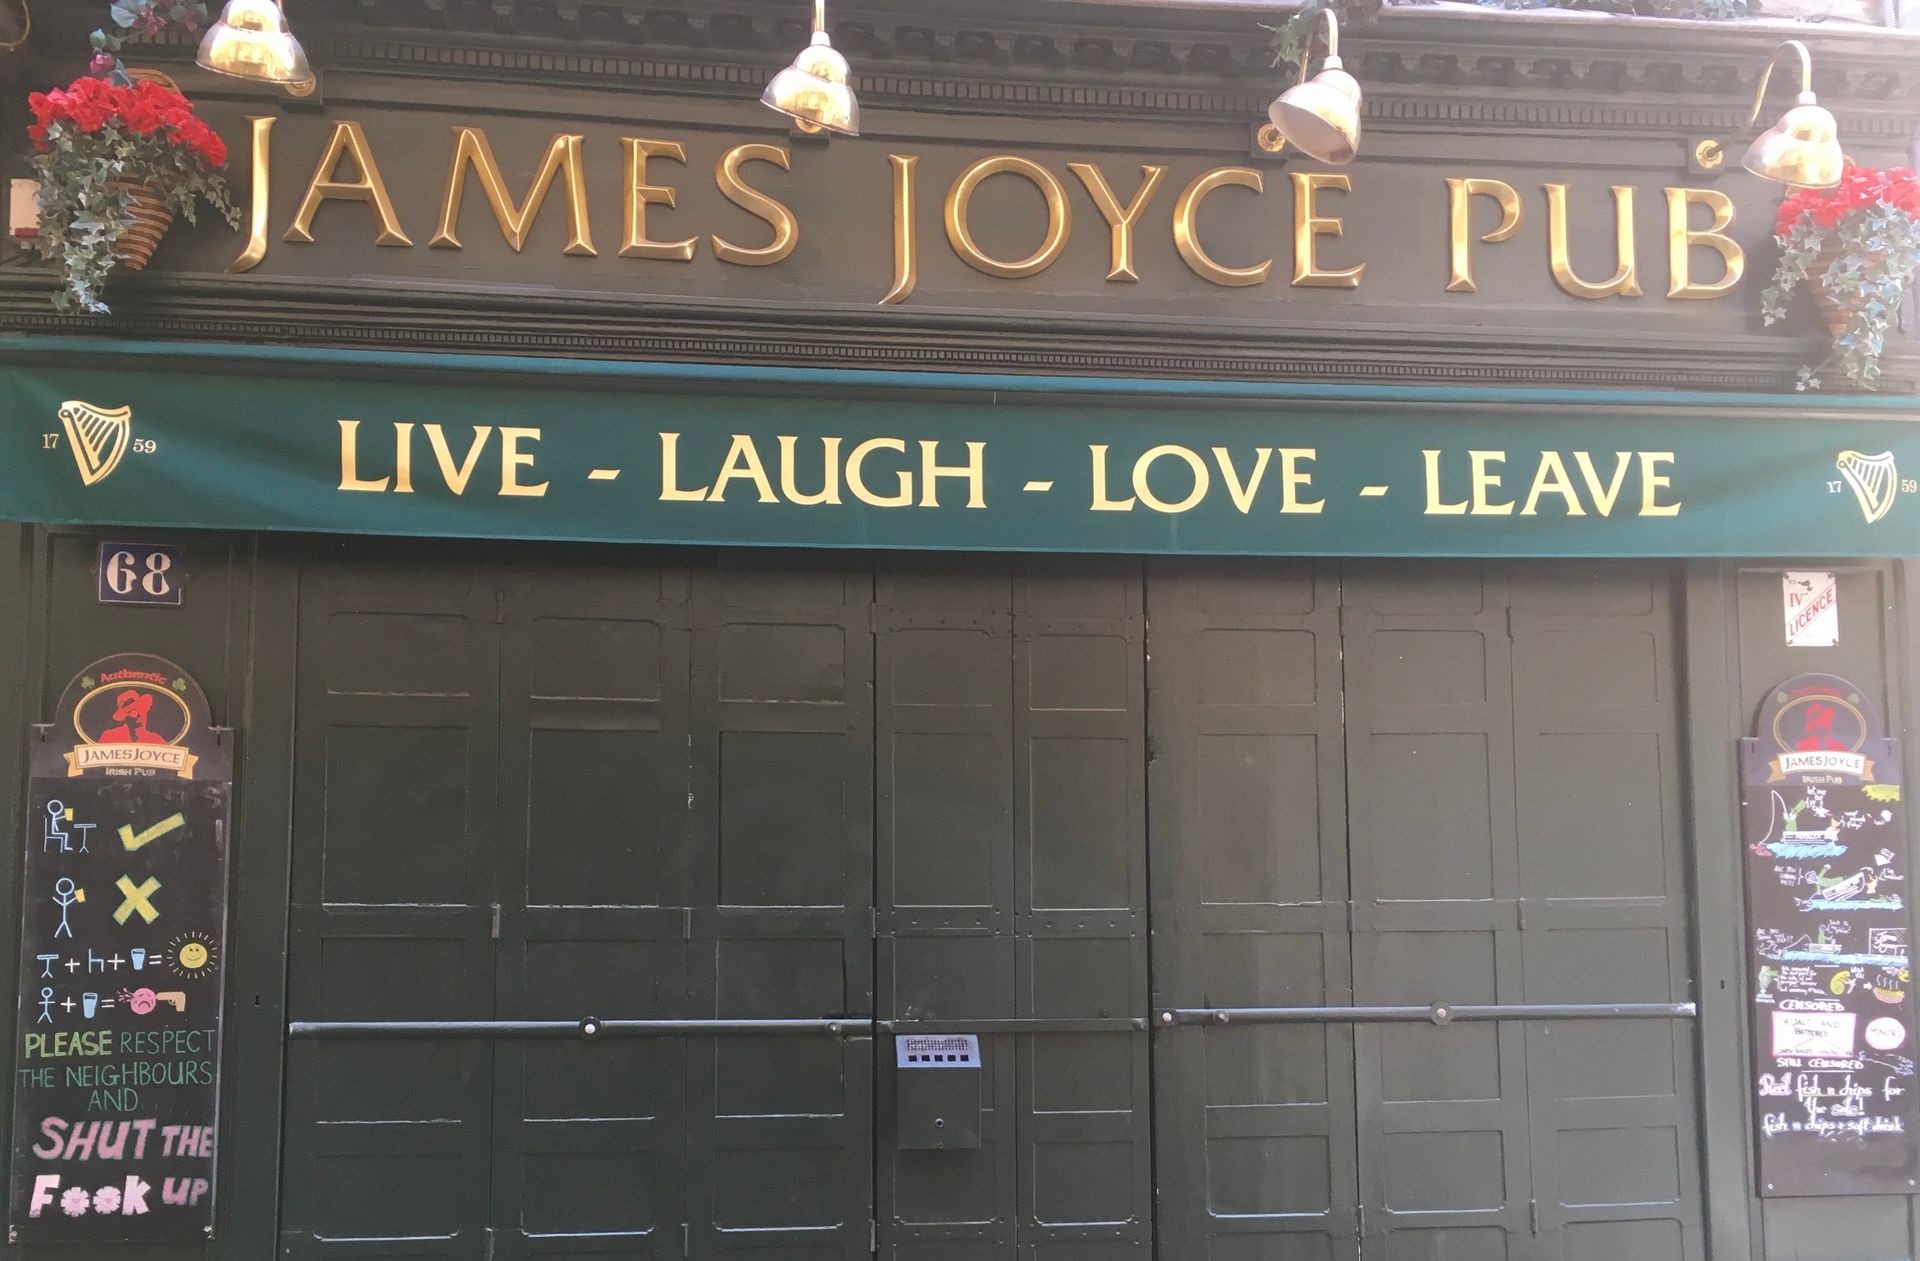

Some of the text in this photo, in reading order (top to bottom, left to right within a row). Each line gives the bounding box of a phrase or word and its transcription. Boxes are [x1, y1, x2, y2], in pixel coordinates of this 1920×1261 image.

[225, 115, 1746, 305] JAMES JOYCE PUB
[42, 433, 157, 453] 17 59
[337, 420, 549, 497] LIVE
[659, 432, 987, 508] LAUGH
[1089, 444, 1325, 515] LOVE
[1422, 450, 1682, 517] LEAVE
[1826, 479, 1918, 493] 17 59
[106, 551, 172, 595] 68
[1789, 587, 1834, 637] LICENCE
[100, 669, 167, 685] Authentic
[105, 767, 156, 777] IRISH PUB
[1802, 775, 1843, 785] IRISH PUB
[1778, 999, 1845, 1011] CENSORED
[25, 1029, 216, 1058] PLEASE RESPECT
[19, 1061, 213, 1088] THE NEIGHBOURS
[1776, 1058, 1865, 1069] STILL CENSORED
[87, 1087, 139, 1112] AND
[1796, 1074, 1822, 1102] fish
[1839, 1074, 1873, 1100] chips
[1882, 1076, 1906, 1101] for
[1762, 1112, 1788, 1137] fish
[1872, 1116, 1904, 1132] drink
[32, 1116, 215, 1161] SHUT THE
[161, 1177, 209, 1206] UP
